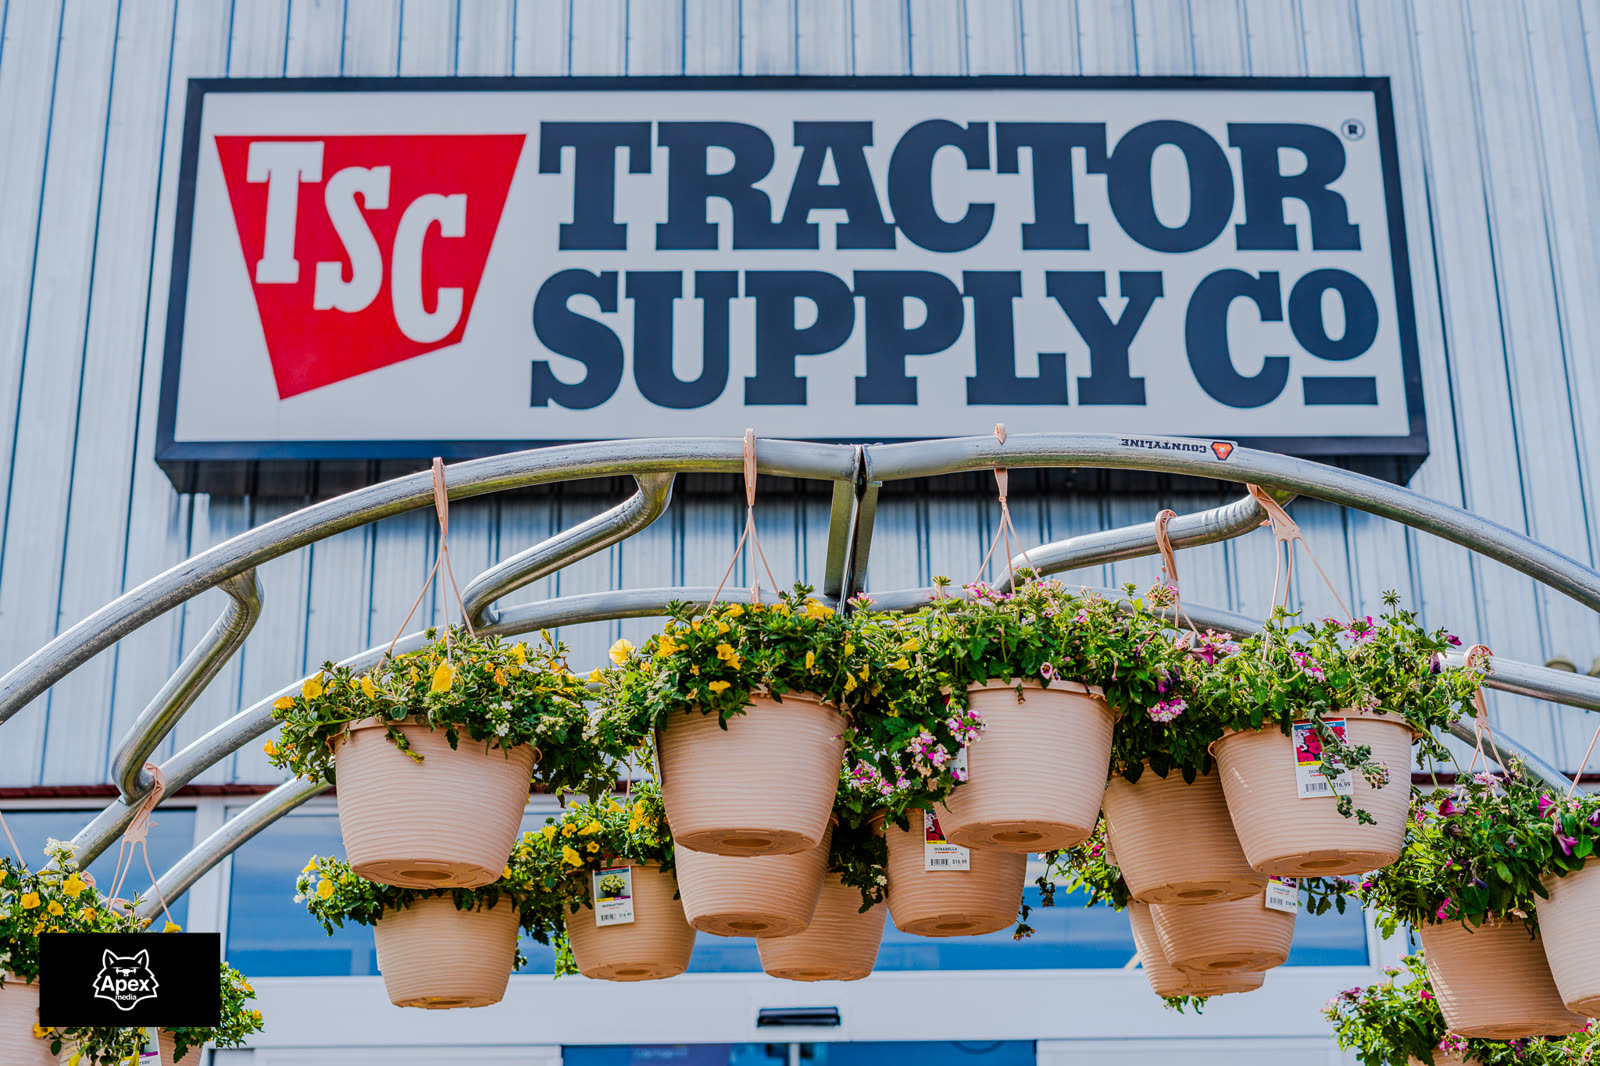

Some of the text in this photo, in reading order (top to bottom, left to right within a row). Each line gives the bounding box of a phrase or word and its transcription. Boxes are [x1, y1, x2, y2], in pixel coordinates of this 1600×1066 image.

[246, 141, 468, 343] TSC
[538, 119, 1362, 253] TRACTOR
[530, 268, 1164, 409] SUPPLY
[1121, 439, 1207, 453] COUNTYLINE
[1333, 781, 1351, 789] $16.99
